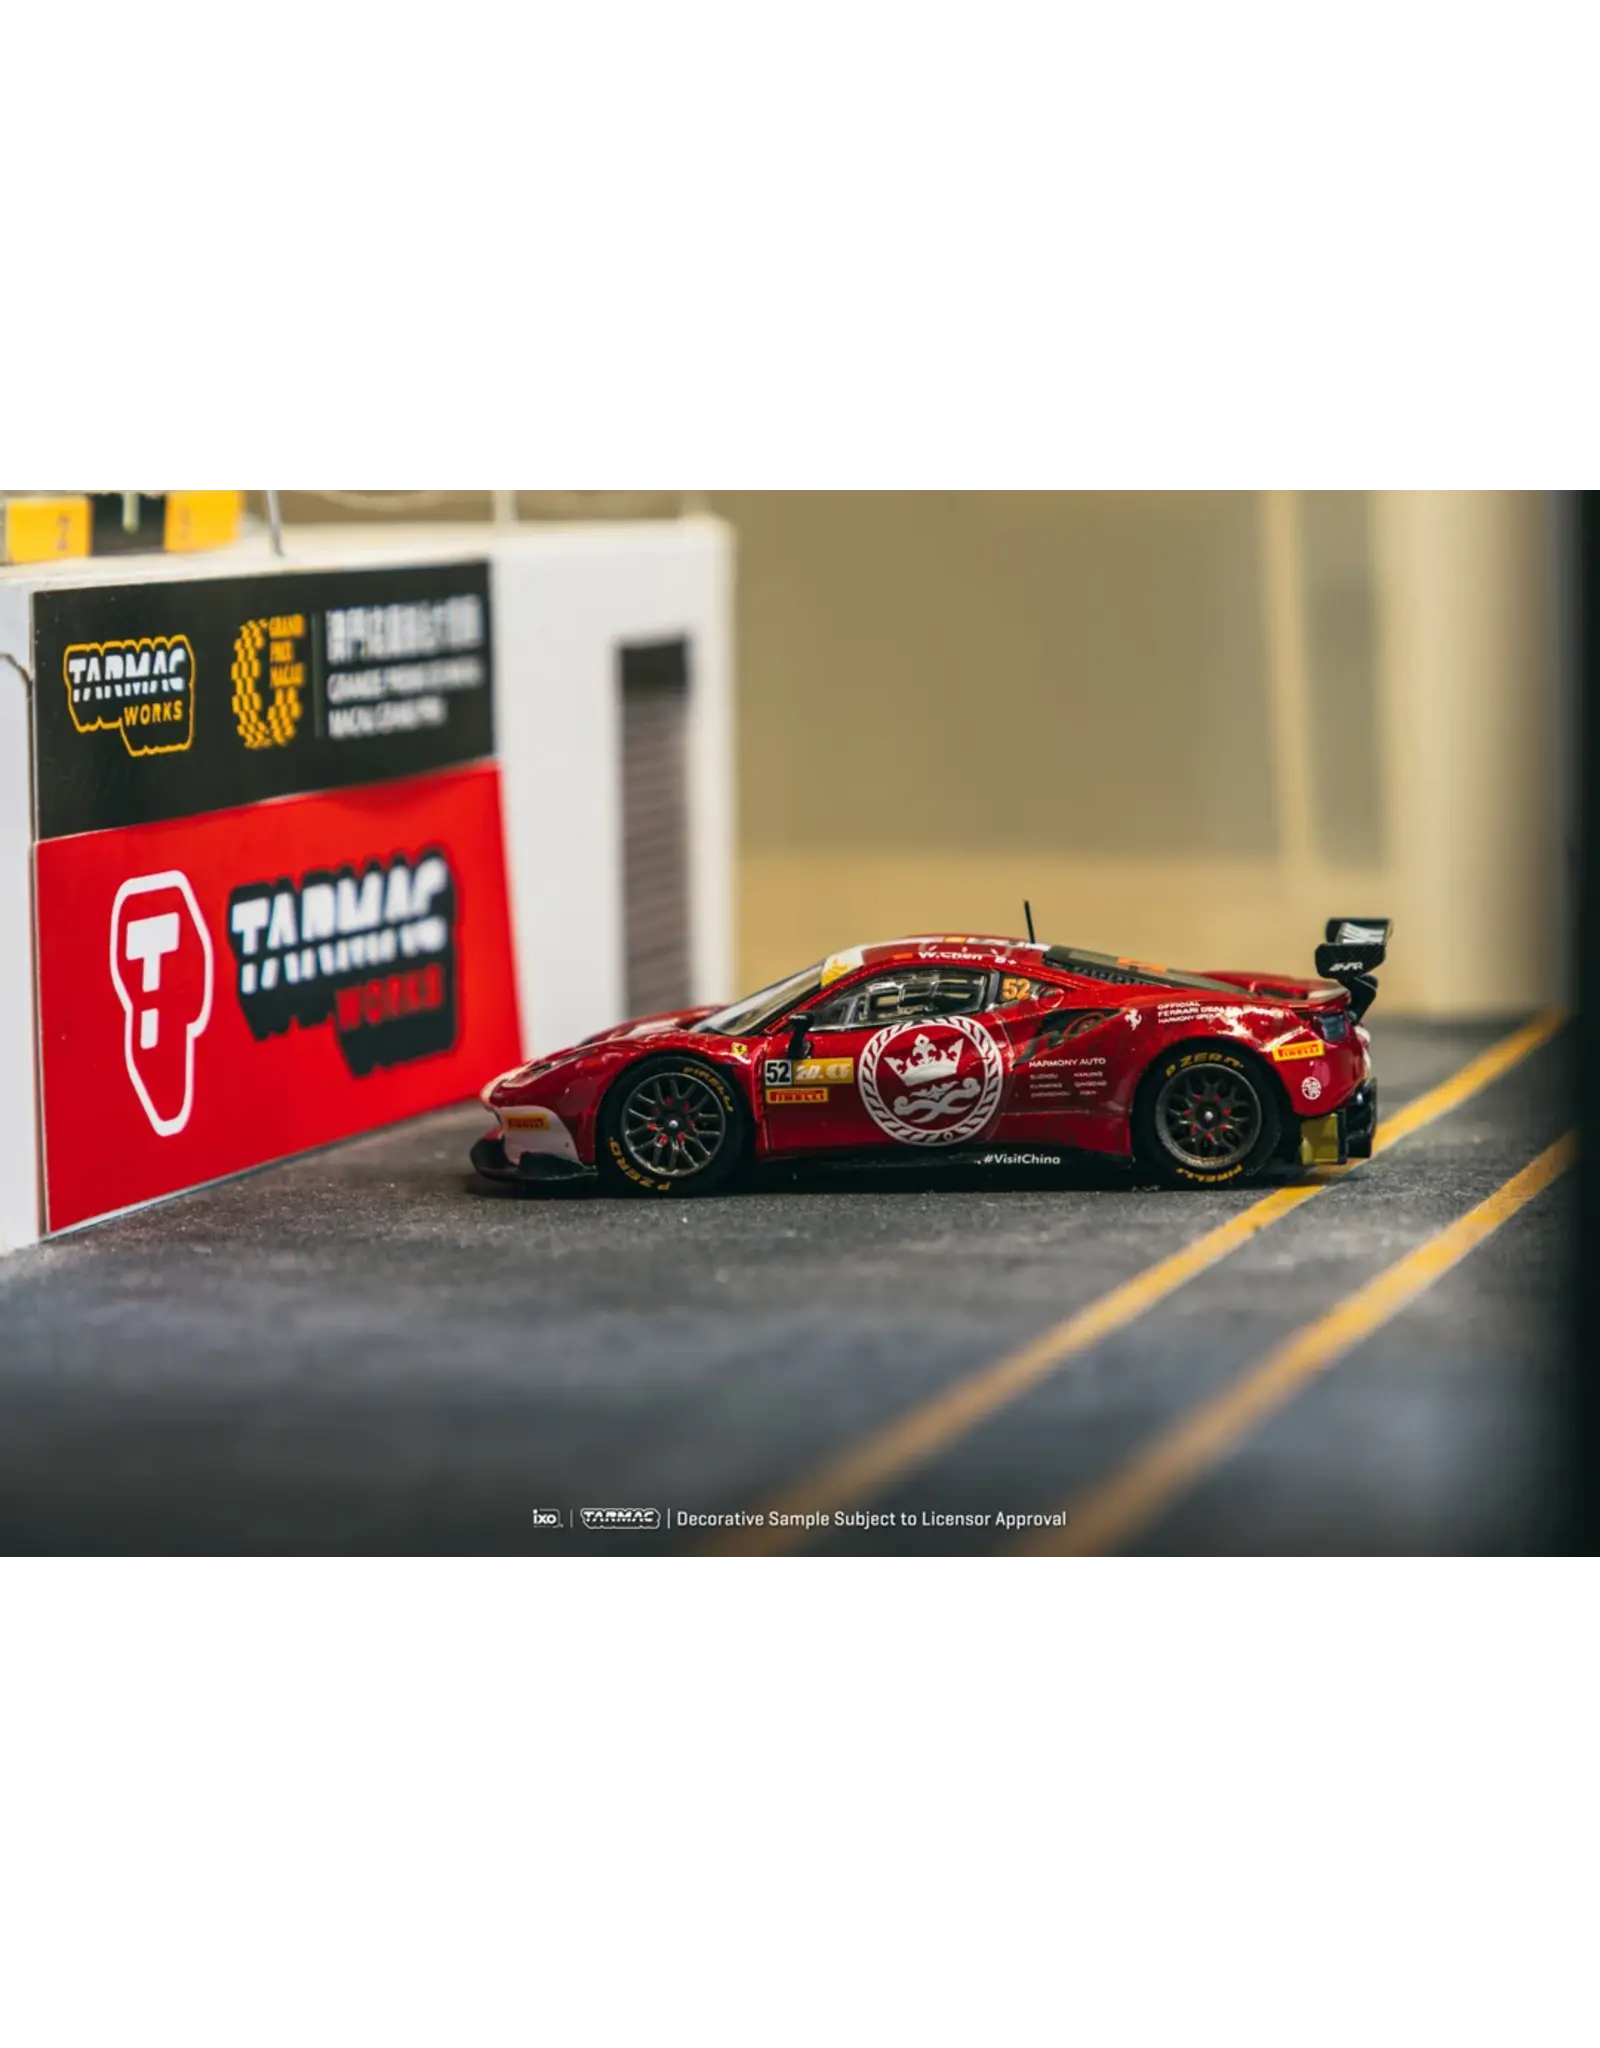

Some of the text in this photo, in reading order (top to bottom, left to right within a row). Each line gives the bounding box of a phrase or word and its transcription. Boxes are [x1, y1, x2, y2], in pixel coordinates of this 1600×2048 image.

[68, 648, 187, 702] TARMAC
[124, 701, 183, 727] WORKS
[231, 856, 448, 995] TARMAC
[336, 964, 444, 1030] WORKS
[1002, 977, 1031, 1000] 52
[767, 1062, 791, 1083] 52
[1029, 1057, 1106, 1068] HARMONY AUTO
[984, 1153, 1061, 1165] #VisitChina
